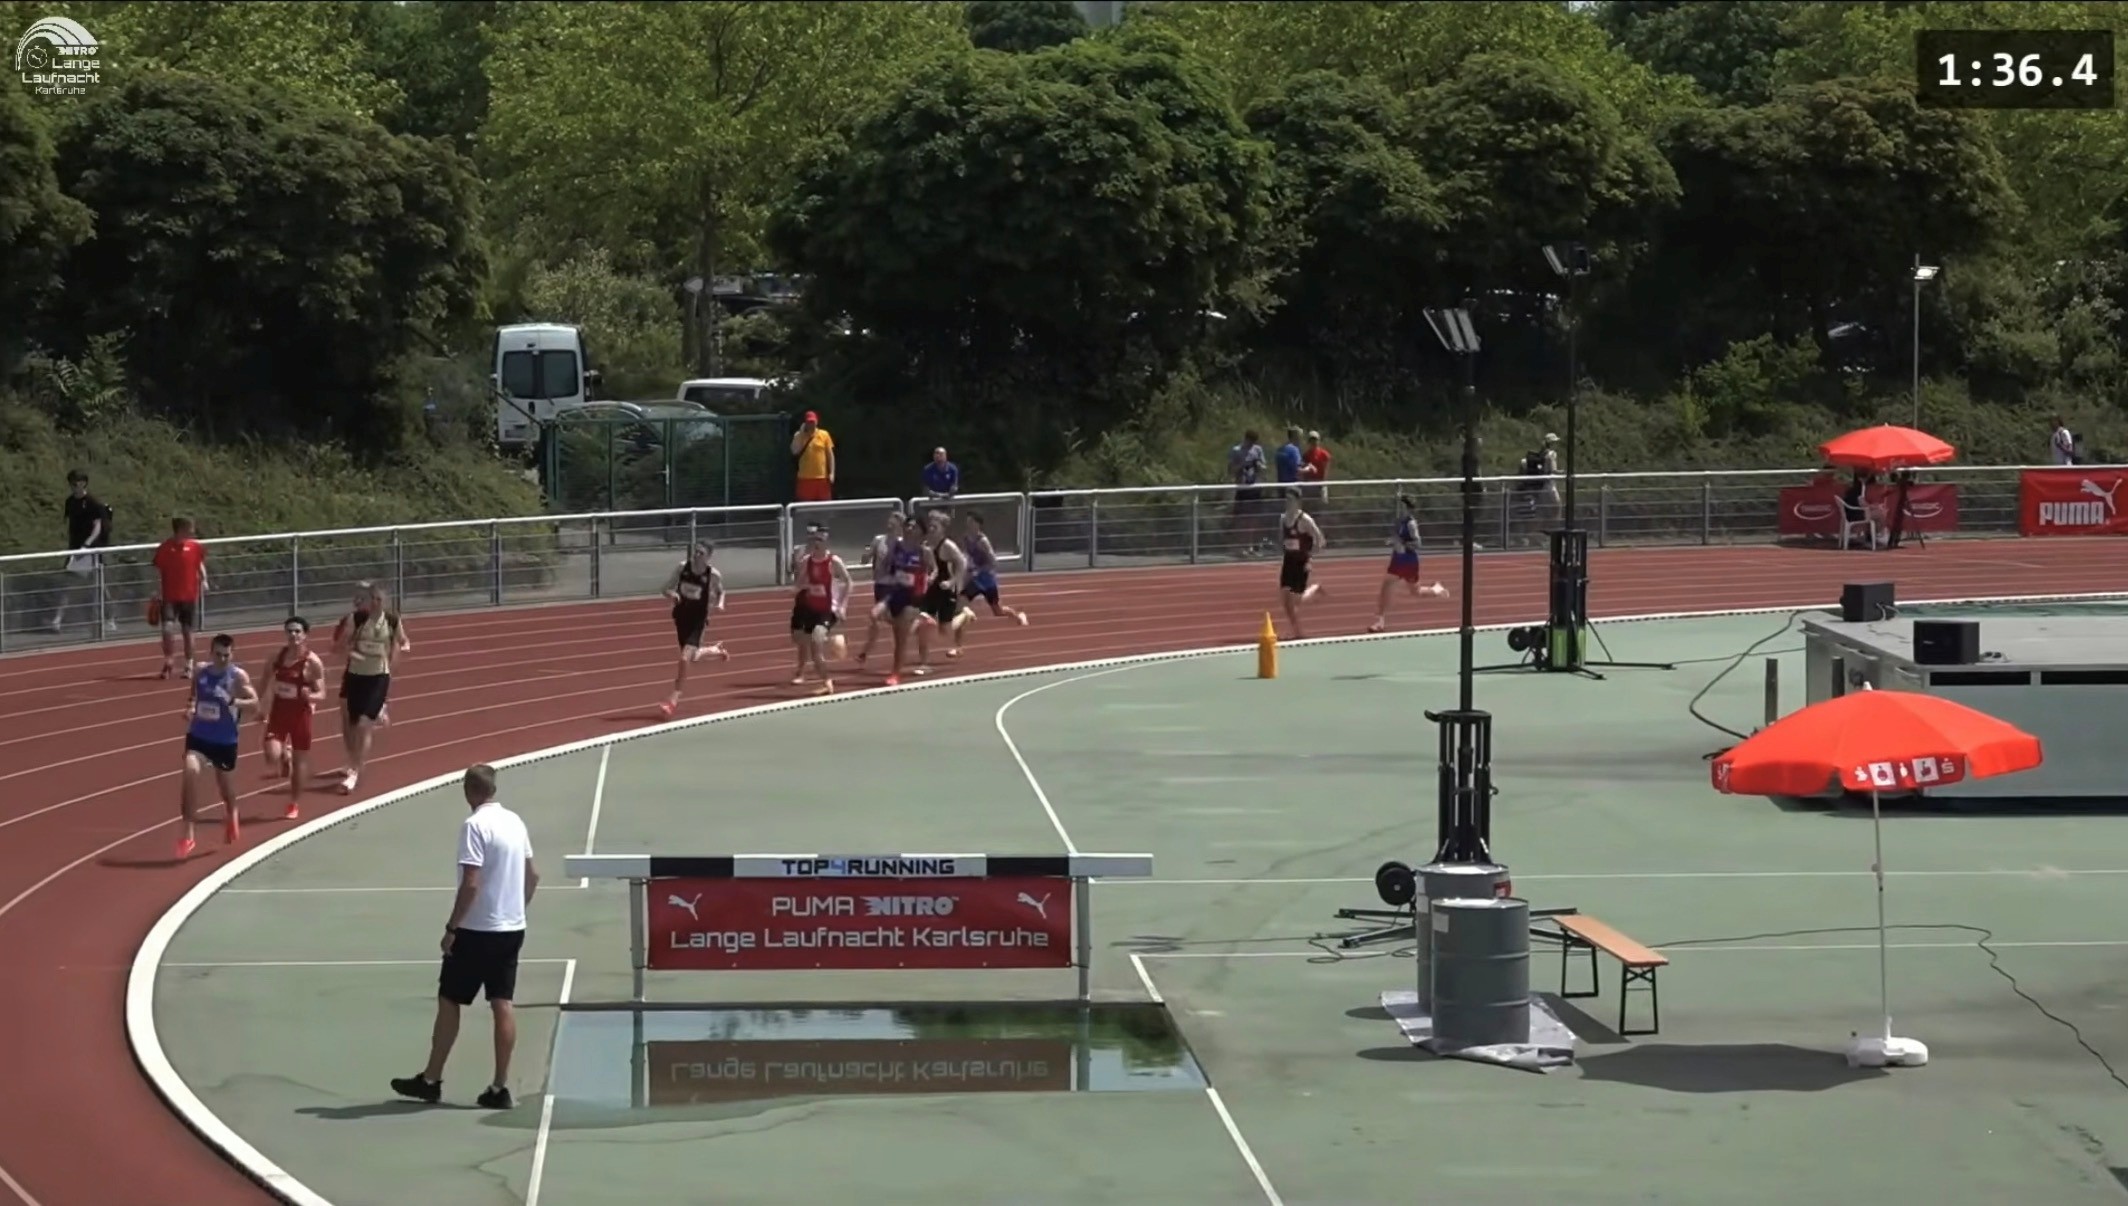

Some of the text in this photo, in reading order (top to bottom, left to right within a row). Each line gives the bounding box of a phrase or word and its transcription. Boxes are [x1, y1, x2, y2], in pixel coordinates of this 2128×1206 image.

[2039, 502, 2104, 526] PUMA
[782, 859, 954, 875] TOP4RUNNING
[772, 896, 954, 917] PUMA NITRO
[670, 926, 1049, 953] Lange Laufnacht Karlsruhe
